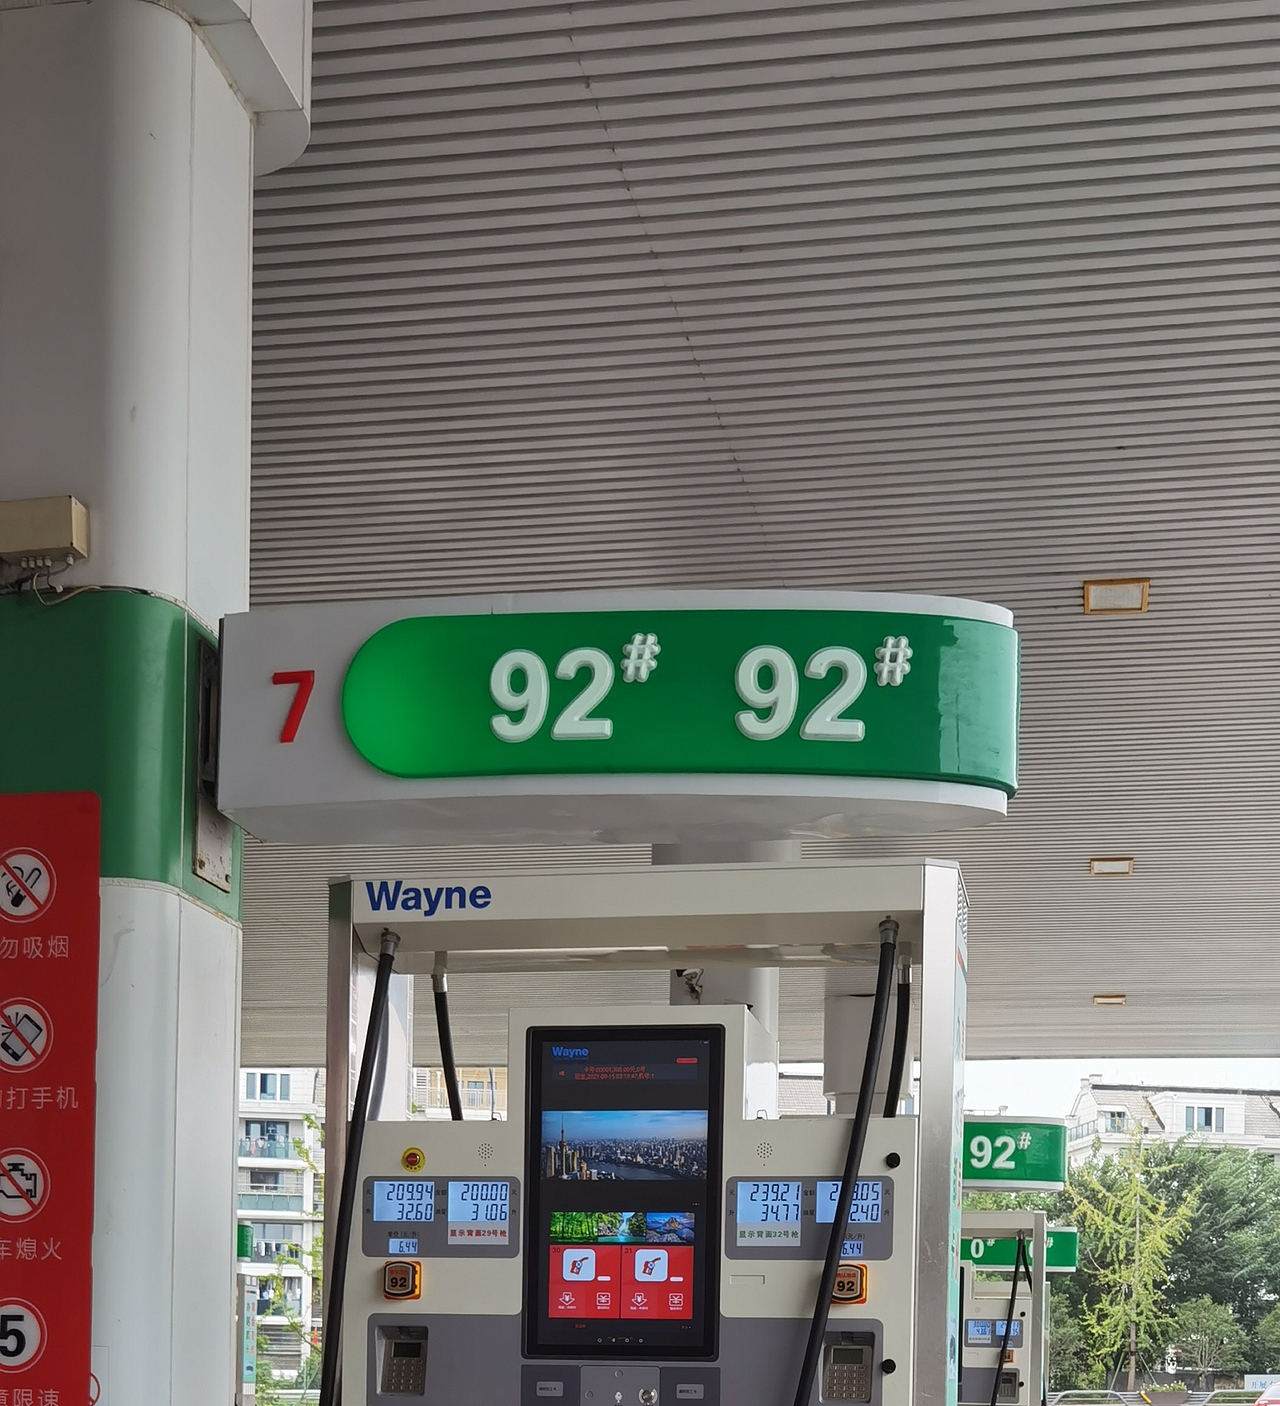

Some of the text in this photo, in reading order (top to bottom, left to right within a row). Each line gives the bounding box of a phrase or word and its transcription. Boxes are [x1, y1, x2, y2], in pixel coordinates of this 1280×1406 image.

[489, 632, 913, 743] 92# 92#
[271, 670, 316, 744] 7
[365, 880, 492, 917] Wayne
[551, 1046, 590, 1058] Wayne
[0, 1086, 79, 1110] 打手机
[969, 1131, 1032, 1169] 92#
[386, 1183, 434, 1201] 209.94
[461, 1183, 509, 1201] 200.00
[750, 1183, 801, 1202] 239.21
[397, 1203, 433, 1221] 32.60
[471, 1203, 508, 1221] 31.06
[760, 1203, 800, 1222] 34.77
[450, 1229, 507, 1237] 显示背面29号枪
[738, 1230, 799, 1239] 显示背面32号枪
[398, 1240, 418, 1253] 6.44
[970, 1238, 996, 1259] 0#
[390, 1276, 408, 1288] 92
[836, 1280, 856, 1293] 92
